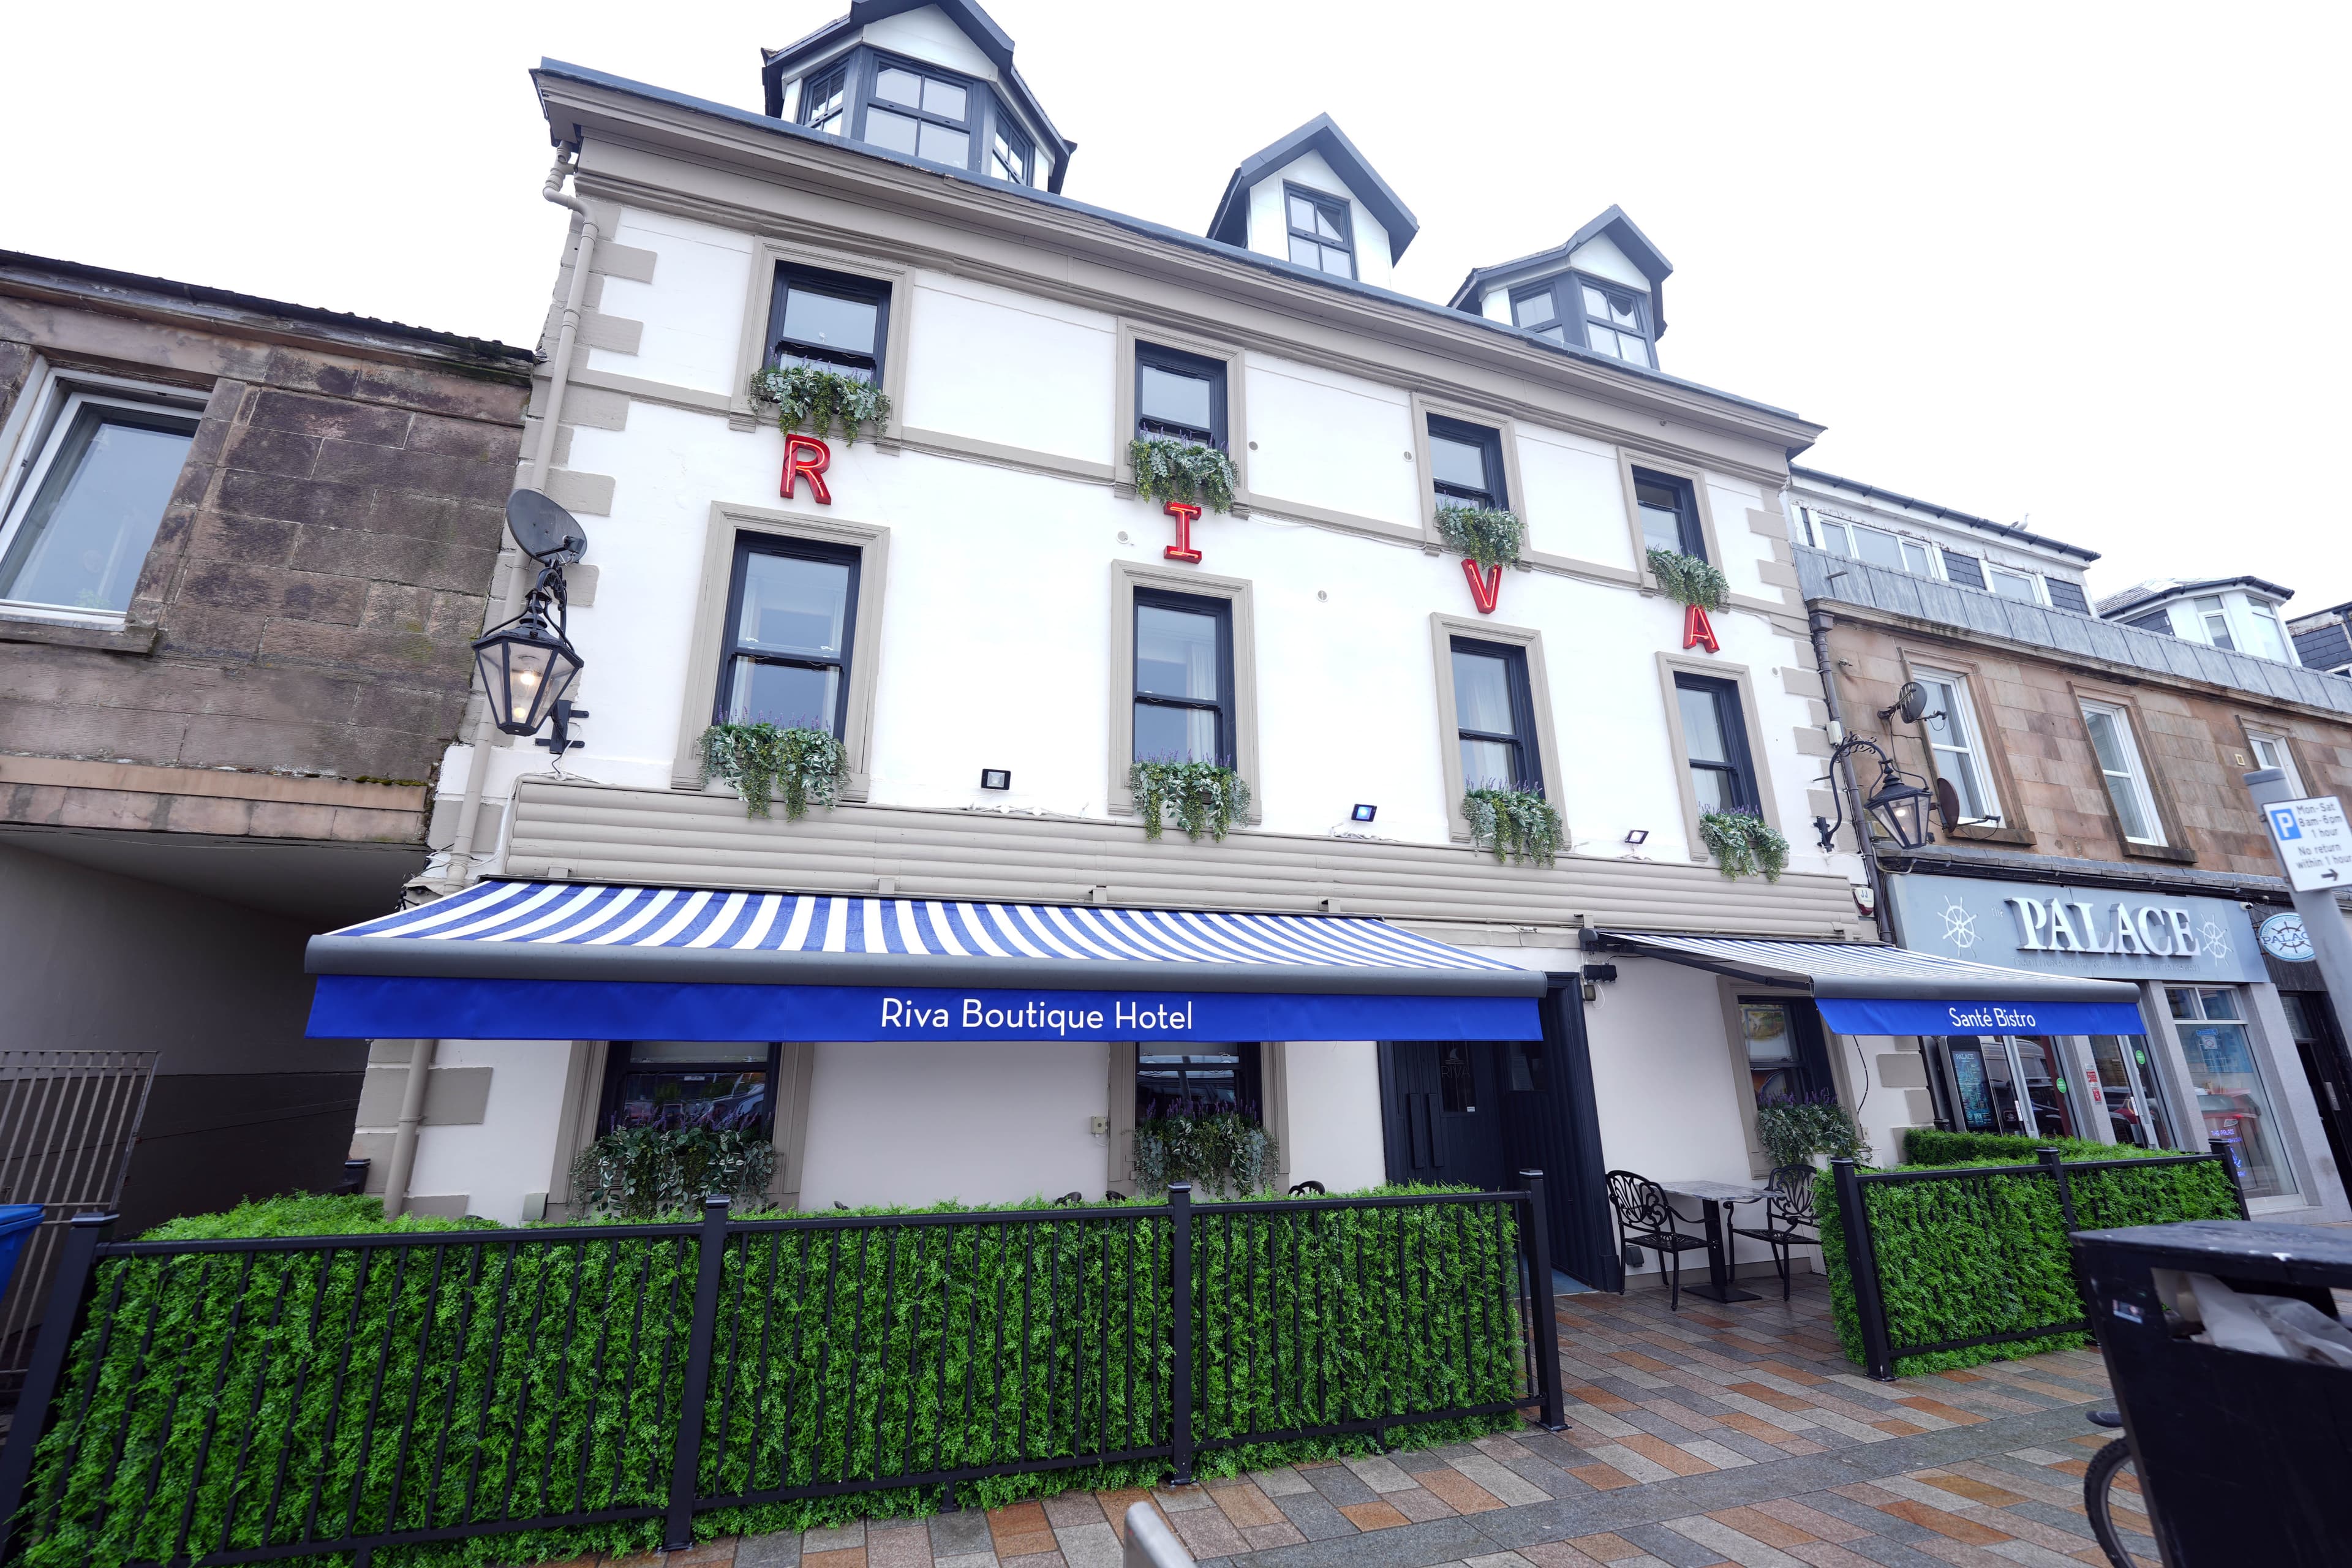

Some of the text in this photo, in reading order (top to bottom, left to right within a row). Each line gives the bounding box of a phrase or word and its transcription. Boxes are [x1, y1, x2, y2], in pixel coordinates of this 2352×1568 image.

[2297, 803, 2336, 815] Mon-Sat
[2275, 812, 2294, 838] P
[2298, 815, 2343, 827] 8am-6pm
[2311, 828, 2339, 838] 1 hour
[2297, 844, 2342, 856] No return
[2296, 855, 2352, 869] within 1 hour
[2004, 897, 2201, 957] PALACE
[2261, 931, 2310, 944] PALAC
[881, 998, 1193, 1036] Riva Boutique Hotel
[1948, 1007, 2036, 1027] Santé Bistro
[1441, 1066, 1470, 1078] RIVA
